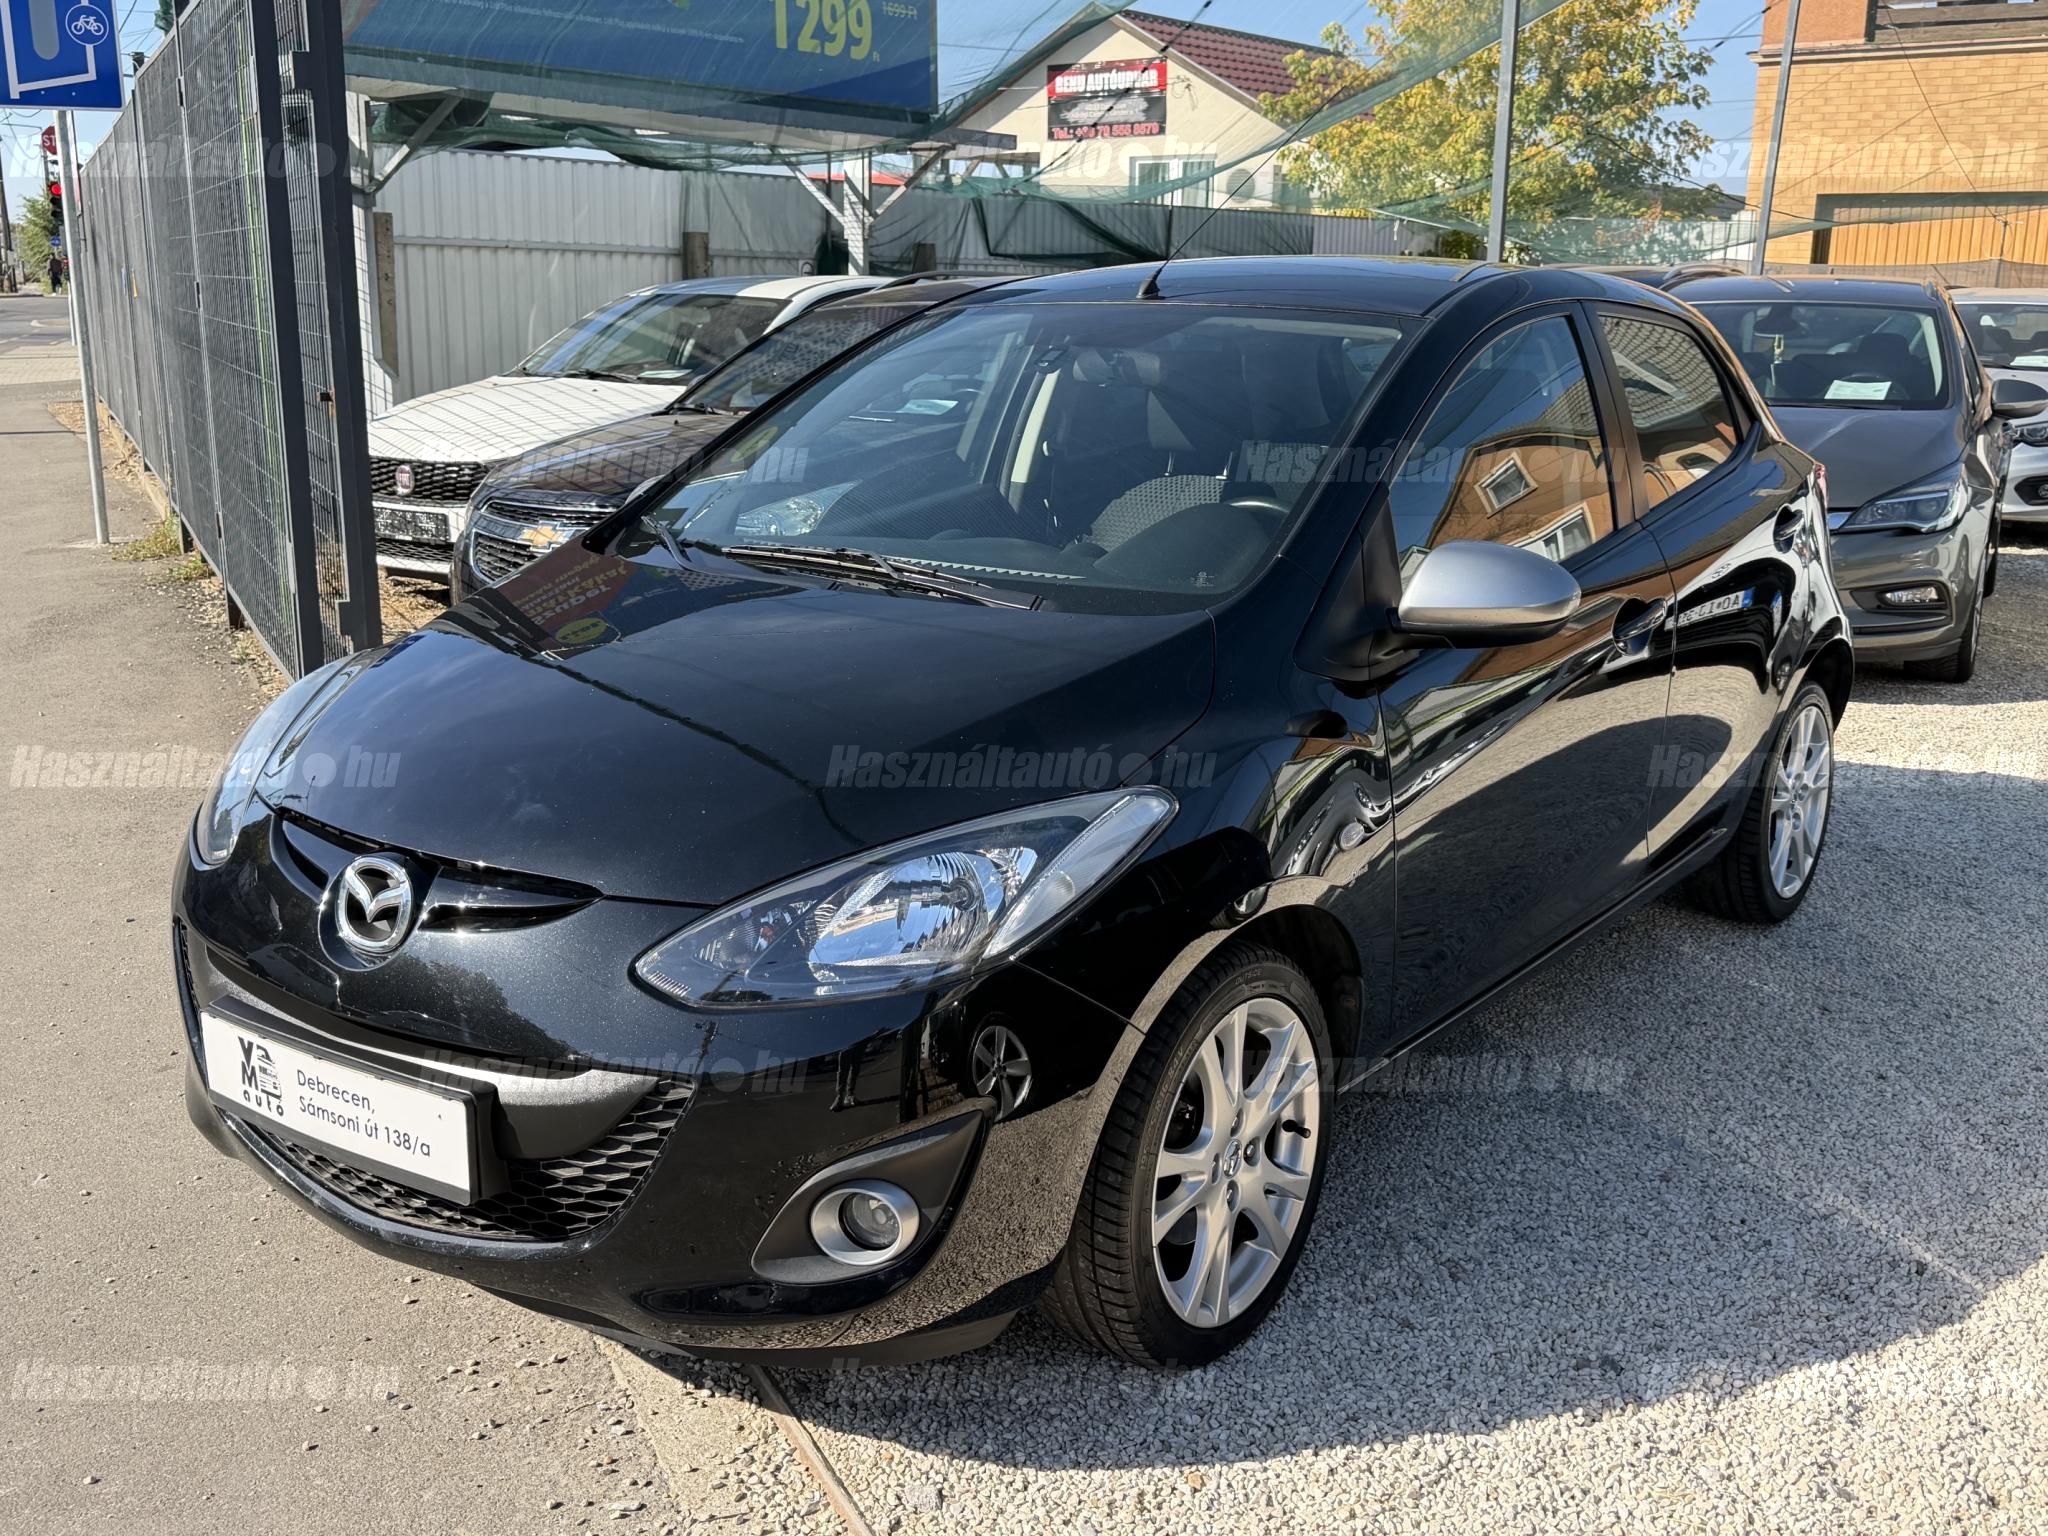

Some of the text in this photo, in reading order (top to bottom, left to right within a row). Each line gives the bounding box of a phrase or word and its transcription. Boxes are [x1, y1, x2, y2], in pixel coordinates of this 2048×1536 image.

[769, 0, 872, 60] 1299
[297, 1069, 375, 1114] Debrecen,
[299, 1095, 431, 1157] Sámsoni út 138/a
